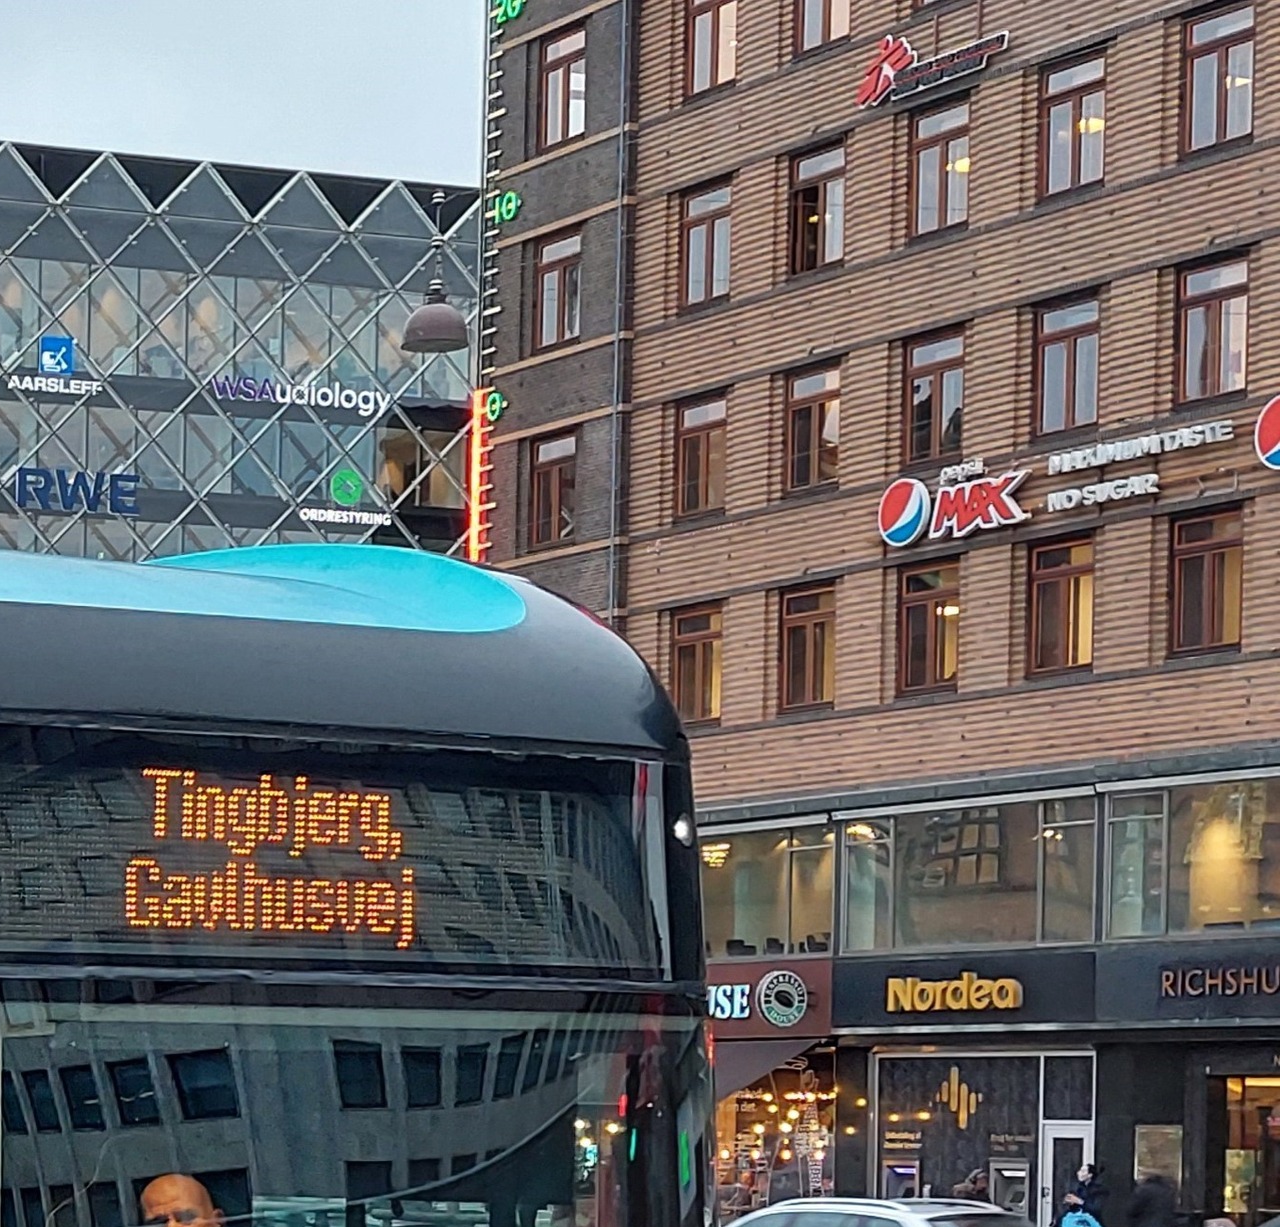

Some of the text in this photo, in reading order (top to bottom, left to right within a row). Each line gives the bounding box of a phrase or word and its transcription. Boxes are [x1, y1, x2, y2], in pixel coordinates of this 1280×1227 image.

[1162, 420, 1234, 452] TASTE
[15, 467, 141, 516] RWE
[931, 470, 1030, 539] MAX
[1048, 473, 1160, 513] NO SUGAR
[124, 859, 416, 948] Gavlhusvej
[886, 971, 1023, 1013] Nordea
[1162, 965, 1280, 997] RICHSHU
